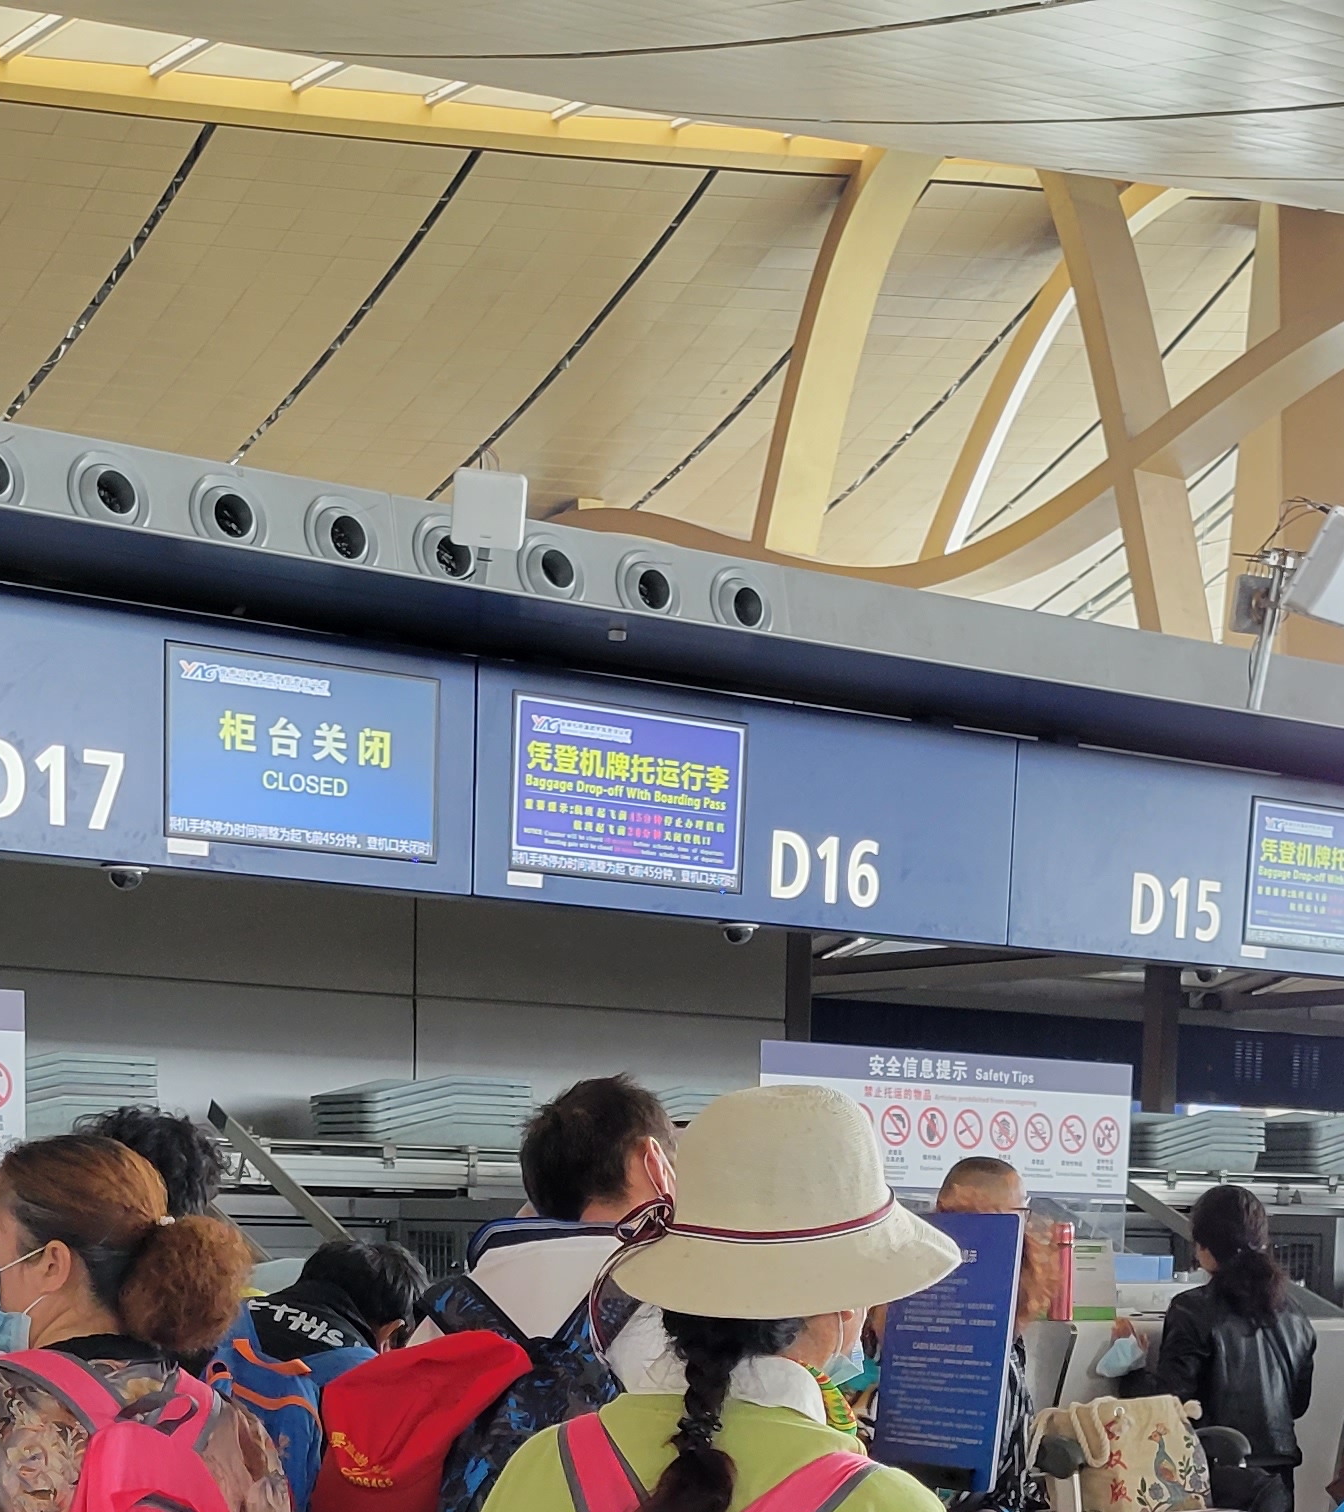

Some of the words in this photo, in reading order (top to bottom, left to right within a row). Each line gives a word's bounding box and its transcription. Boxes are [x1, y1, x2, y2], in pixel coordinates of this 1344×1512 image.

[219, 710, 392, 769] 柜台关闭
[262, 770, 349, 797] CLOSED
[527, 740, 729, 794] 凭登机牌托运行李
[525, 774, 573, 792] Baggage
[576, 780, 625, 798] Drop-off
[626, 787, 651, 801] With
[654, 791, 702, 811] Boarding
[703, 798, 727, 811] Pass
[770, 828, 881, 911] D16
[1130, 872, 1223, 943] D15
[869, 1054, 968, 1081] 安全信息提示
[975, 1068, 1010, 1084] Safety
[1012, 1070, 1035, 1084] Tips
[864, 1085, 932, 1101] 禁止托运的物品
